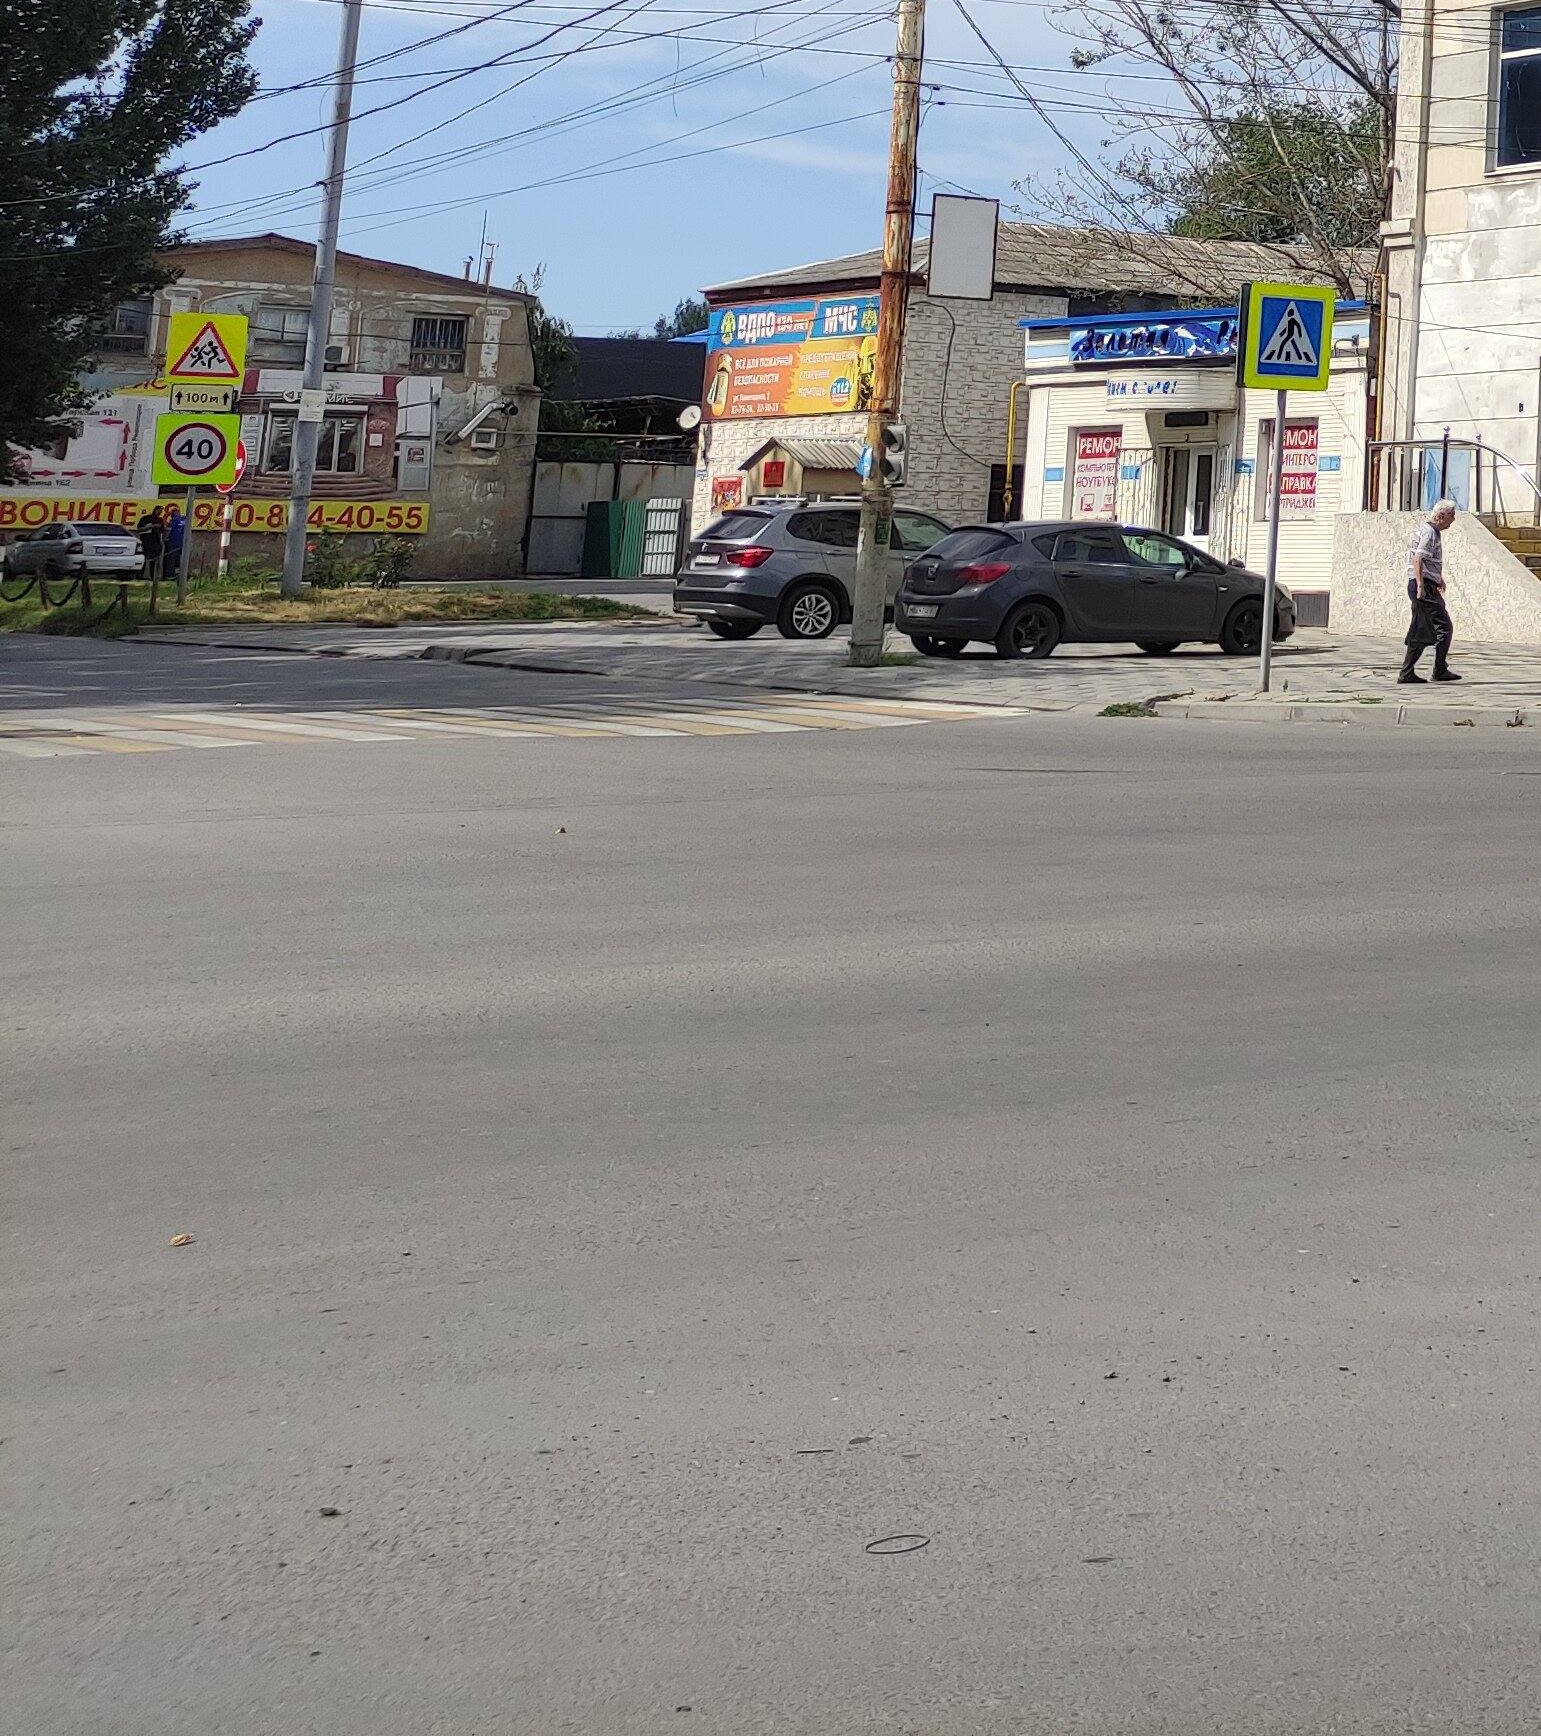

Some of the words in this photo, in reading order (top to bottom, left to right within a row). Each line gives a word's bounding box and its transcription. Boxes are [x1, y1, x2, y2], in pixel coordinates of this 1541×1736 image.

[737, 312, 777, 344] ВДПО
[824, 305, 858, 334] МЧС
[175, 438, 214, 460] 40
